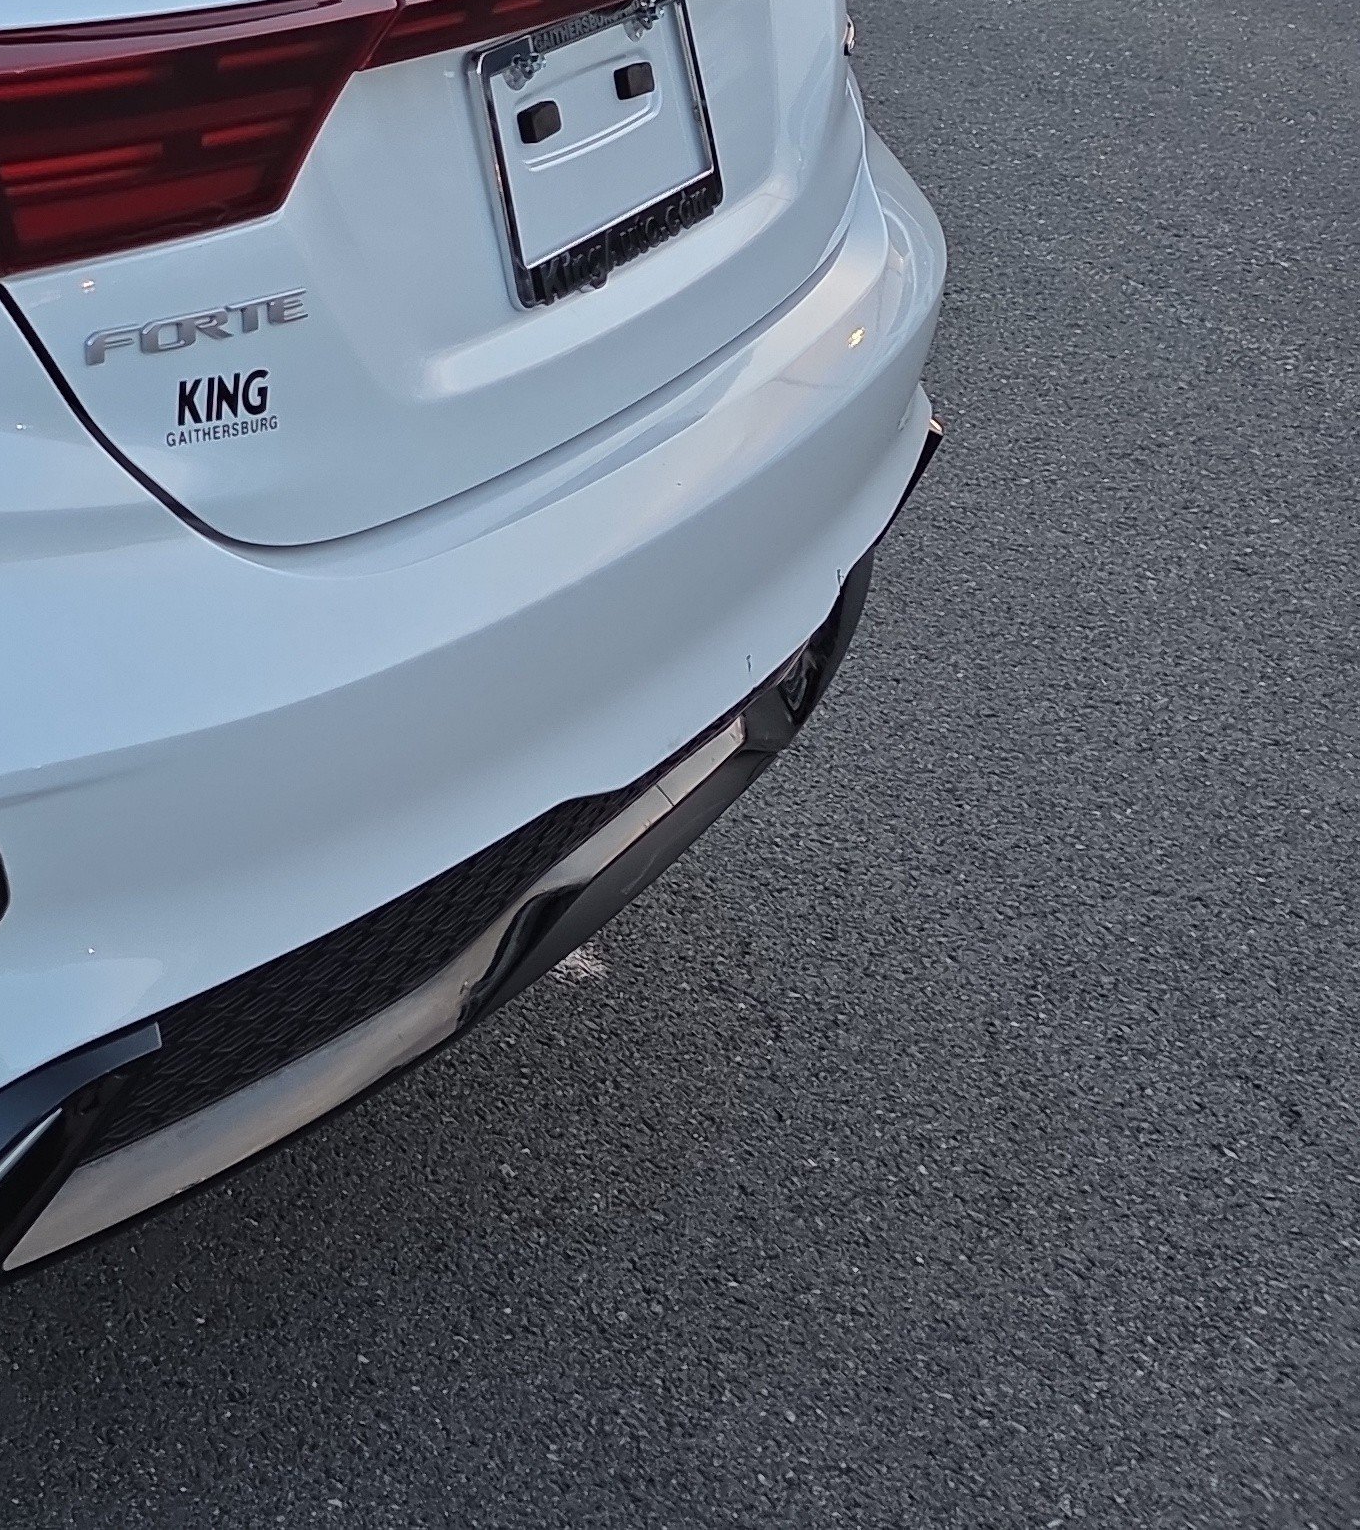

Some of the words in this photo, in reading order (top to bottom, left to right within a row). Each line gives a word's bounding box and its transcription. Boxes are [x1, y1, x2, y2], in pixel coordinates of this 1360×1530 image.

[84, 286, 309, 366] FORTE
[178, 369, 270, 427] KING
[166, 415, 279, 448] GAITHERSBURG
